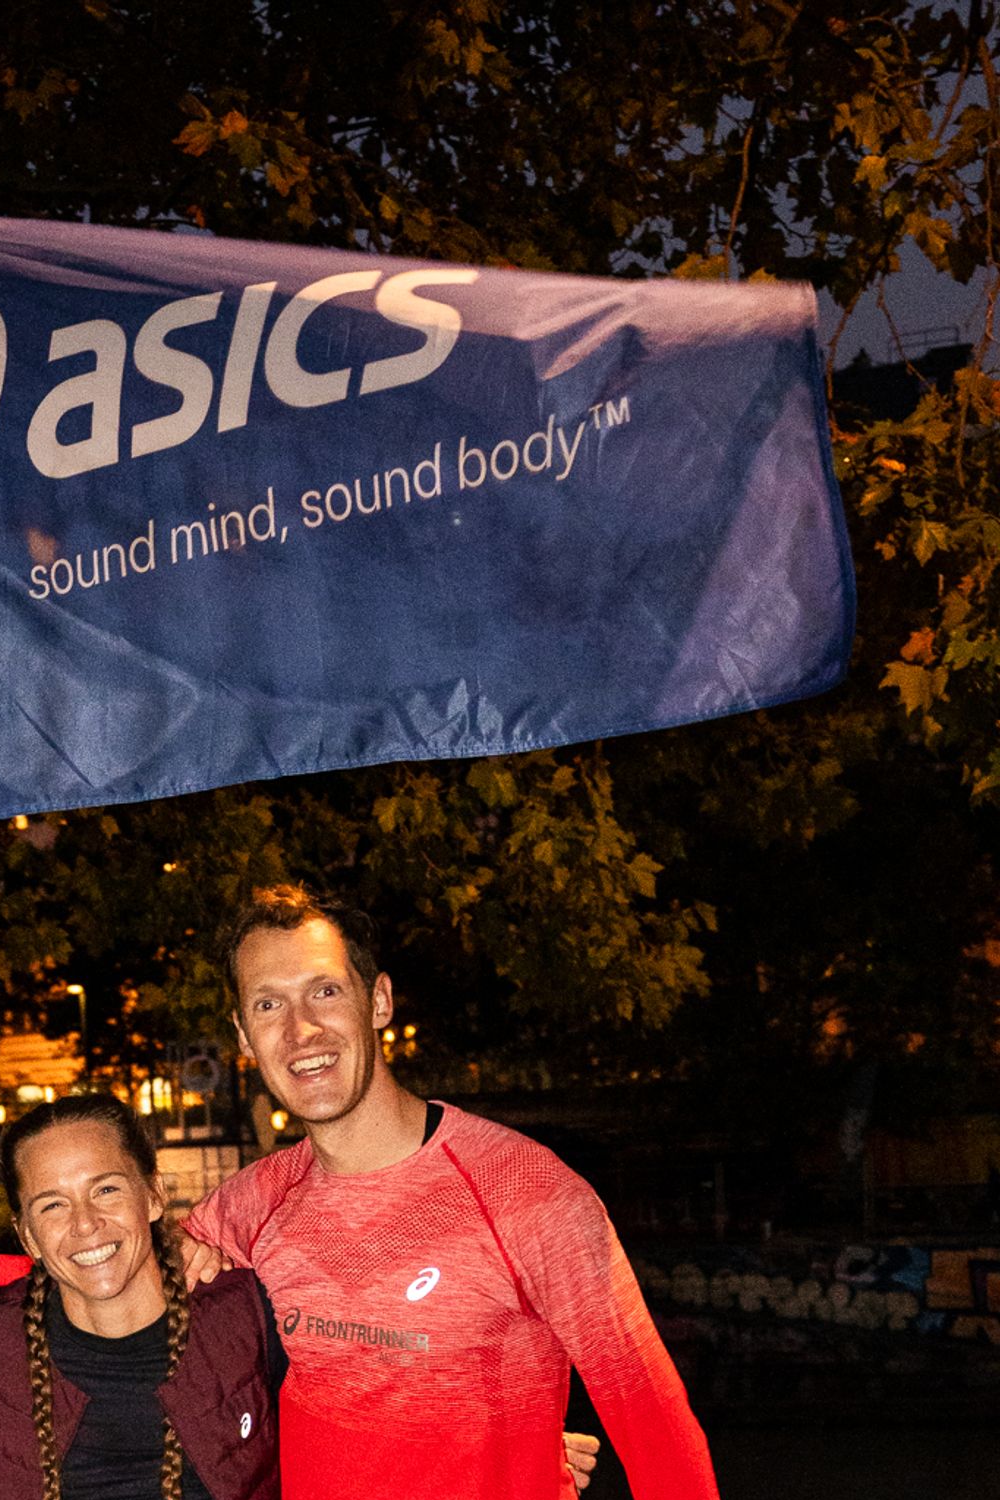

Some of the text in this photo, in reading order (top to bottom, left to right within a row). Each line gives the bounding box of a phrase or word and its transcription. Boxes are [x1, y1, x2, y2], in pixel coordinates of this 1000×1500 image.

[28, 518, 156, 601] sound
[169, 487, 290, 569] mind,
[301, 442, 443, 530] sound
[306, 1315, 429, 1352] FRONTRUNNER
